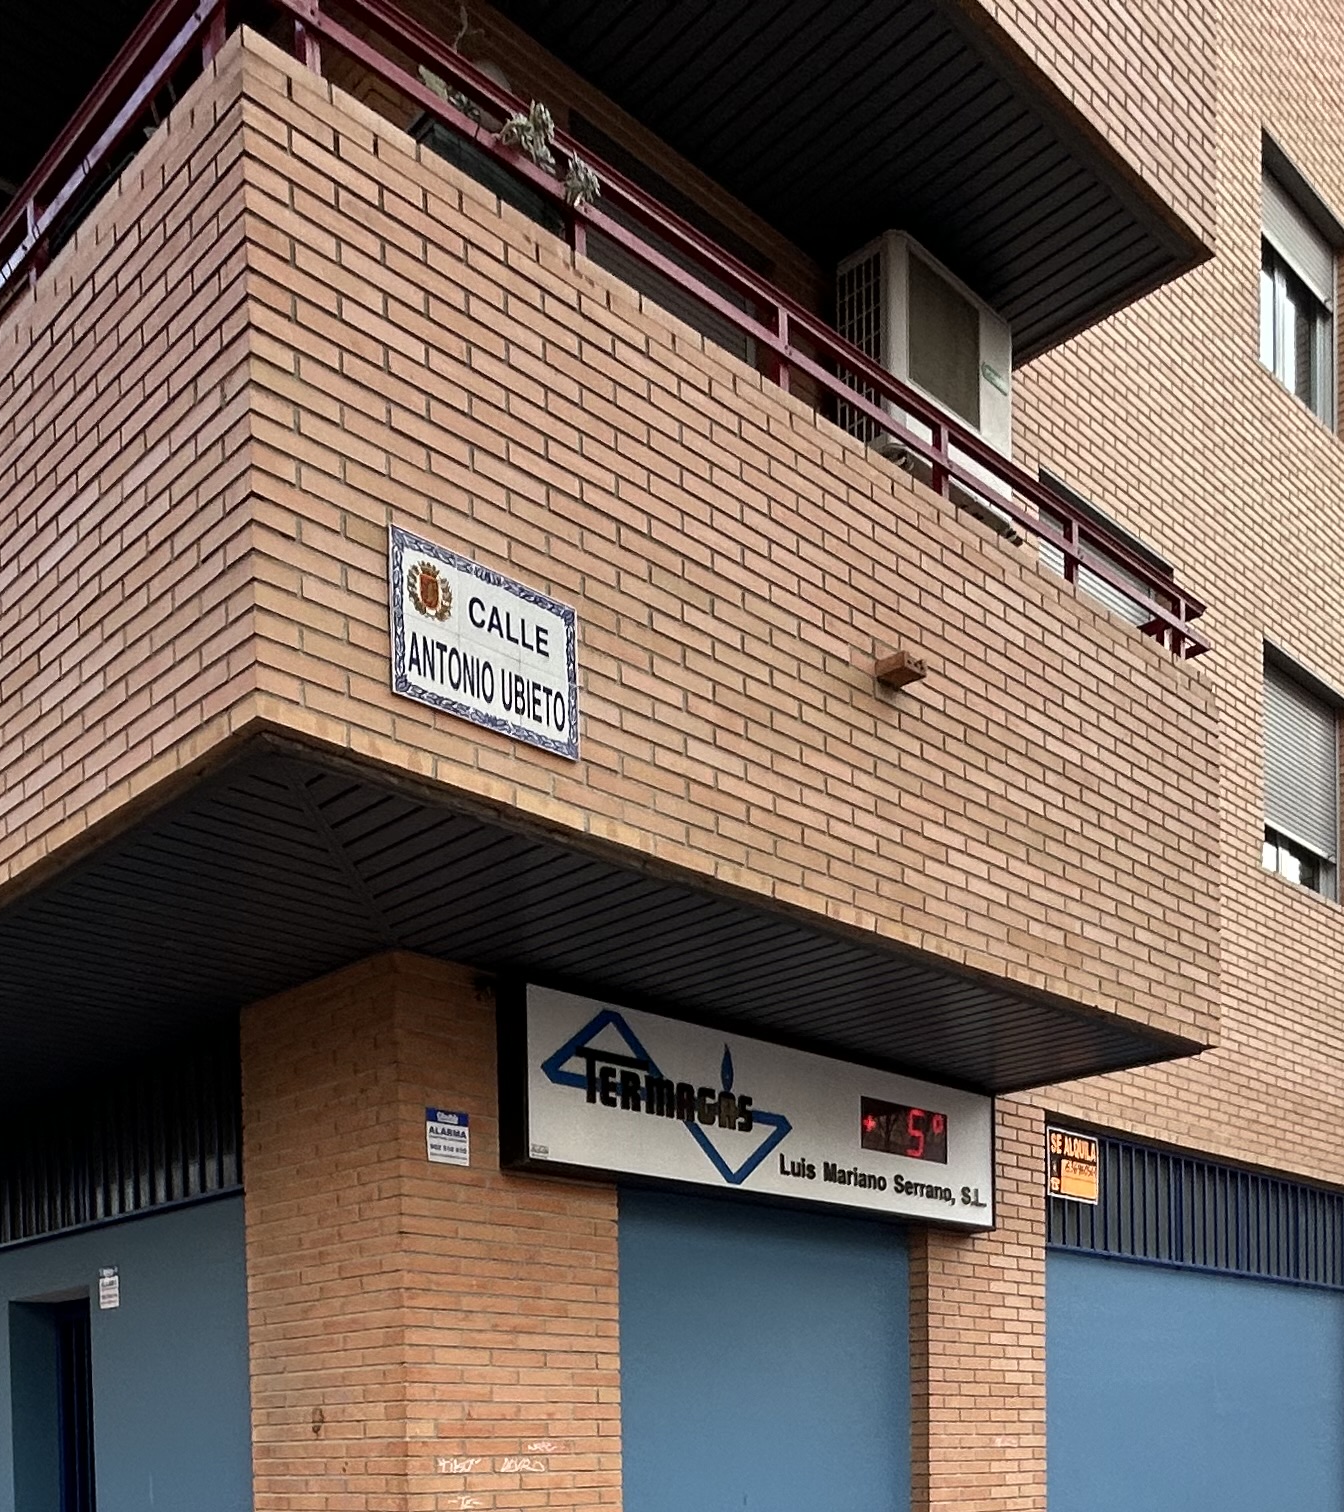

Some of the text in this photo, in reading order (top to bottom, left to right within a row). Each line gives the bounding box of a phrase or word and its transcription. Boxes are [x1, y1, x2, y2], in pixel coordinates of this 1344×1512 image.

[468, 597, 550, 658] CALLE
[408, 631, 566, 732] ANTONIO UBIETO
[429, 1125, 467, 1139] ALARMA
[1050, 1132, 1096, 1163] SE ALQUILA
[779, 1153, 816, 1180] Luis
[823, 1161, 887, 1191] Mariano
[893, 1174, 956, 1206] Serrano,
